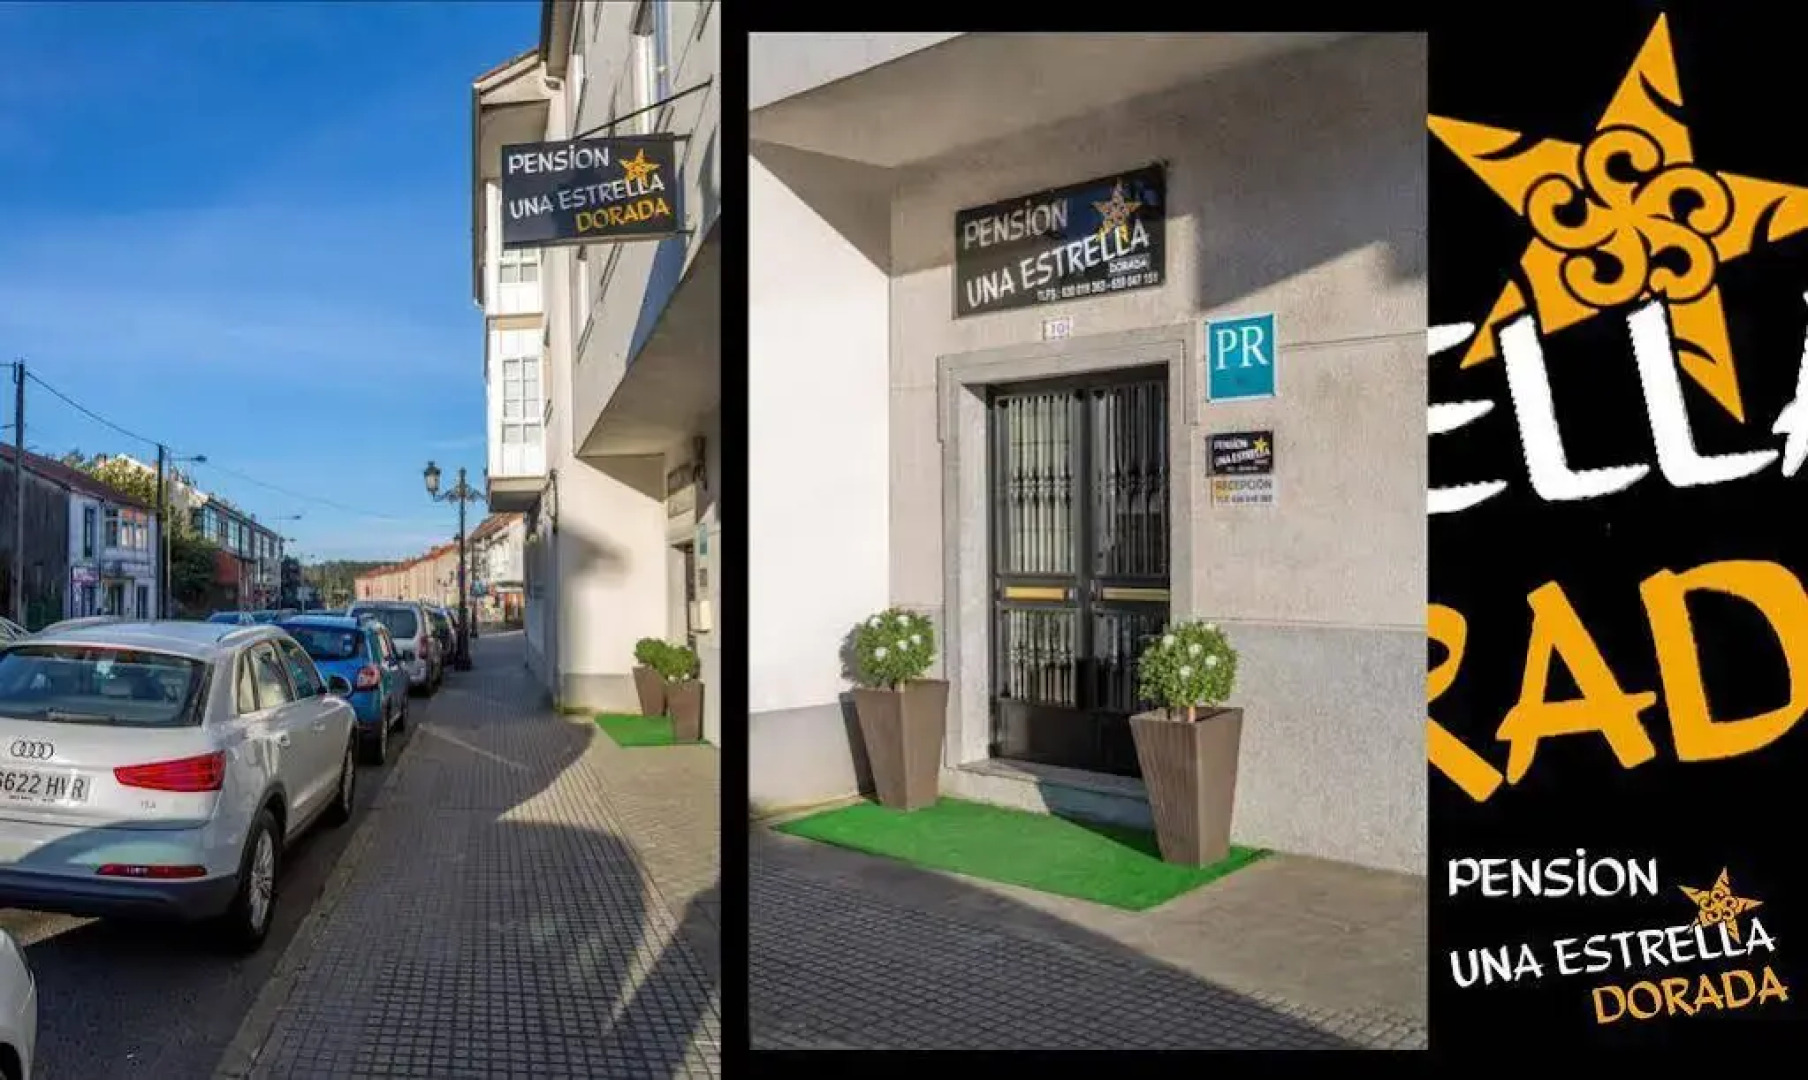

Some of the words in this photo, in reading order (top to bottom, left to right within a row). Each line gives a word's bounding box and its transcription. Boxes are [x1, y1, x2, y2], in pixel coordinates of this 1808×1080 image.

[510, 197, 553, 219] UNA
[557, 172, 666, 210] ESTRELLA
[574, 197, 671, 232] DORADA
[966, 266, 1015, 308] UNA
[1020, 218, 1150, 290] ESTRELLA
[1215, 326, 1270, 370] PR
[0, 771, 41, 794] 622
